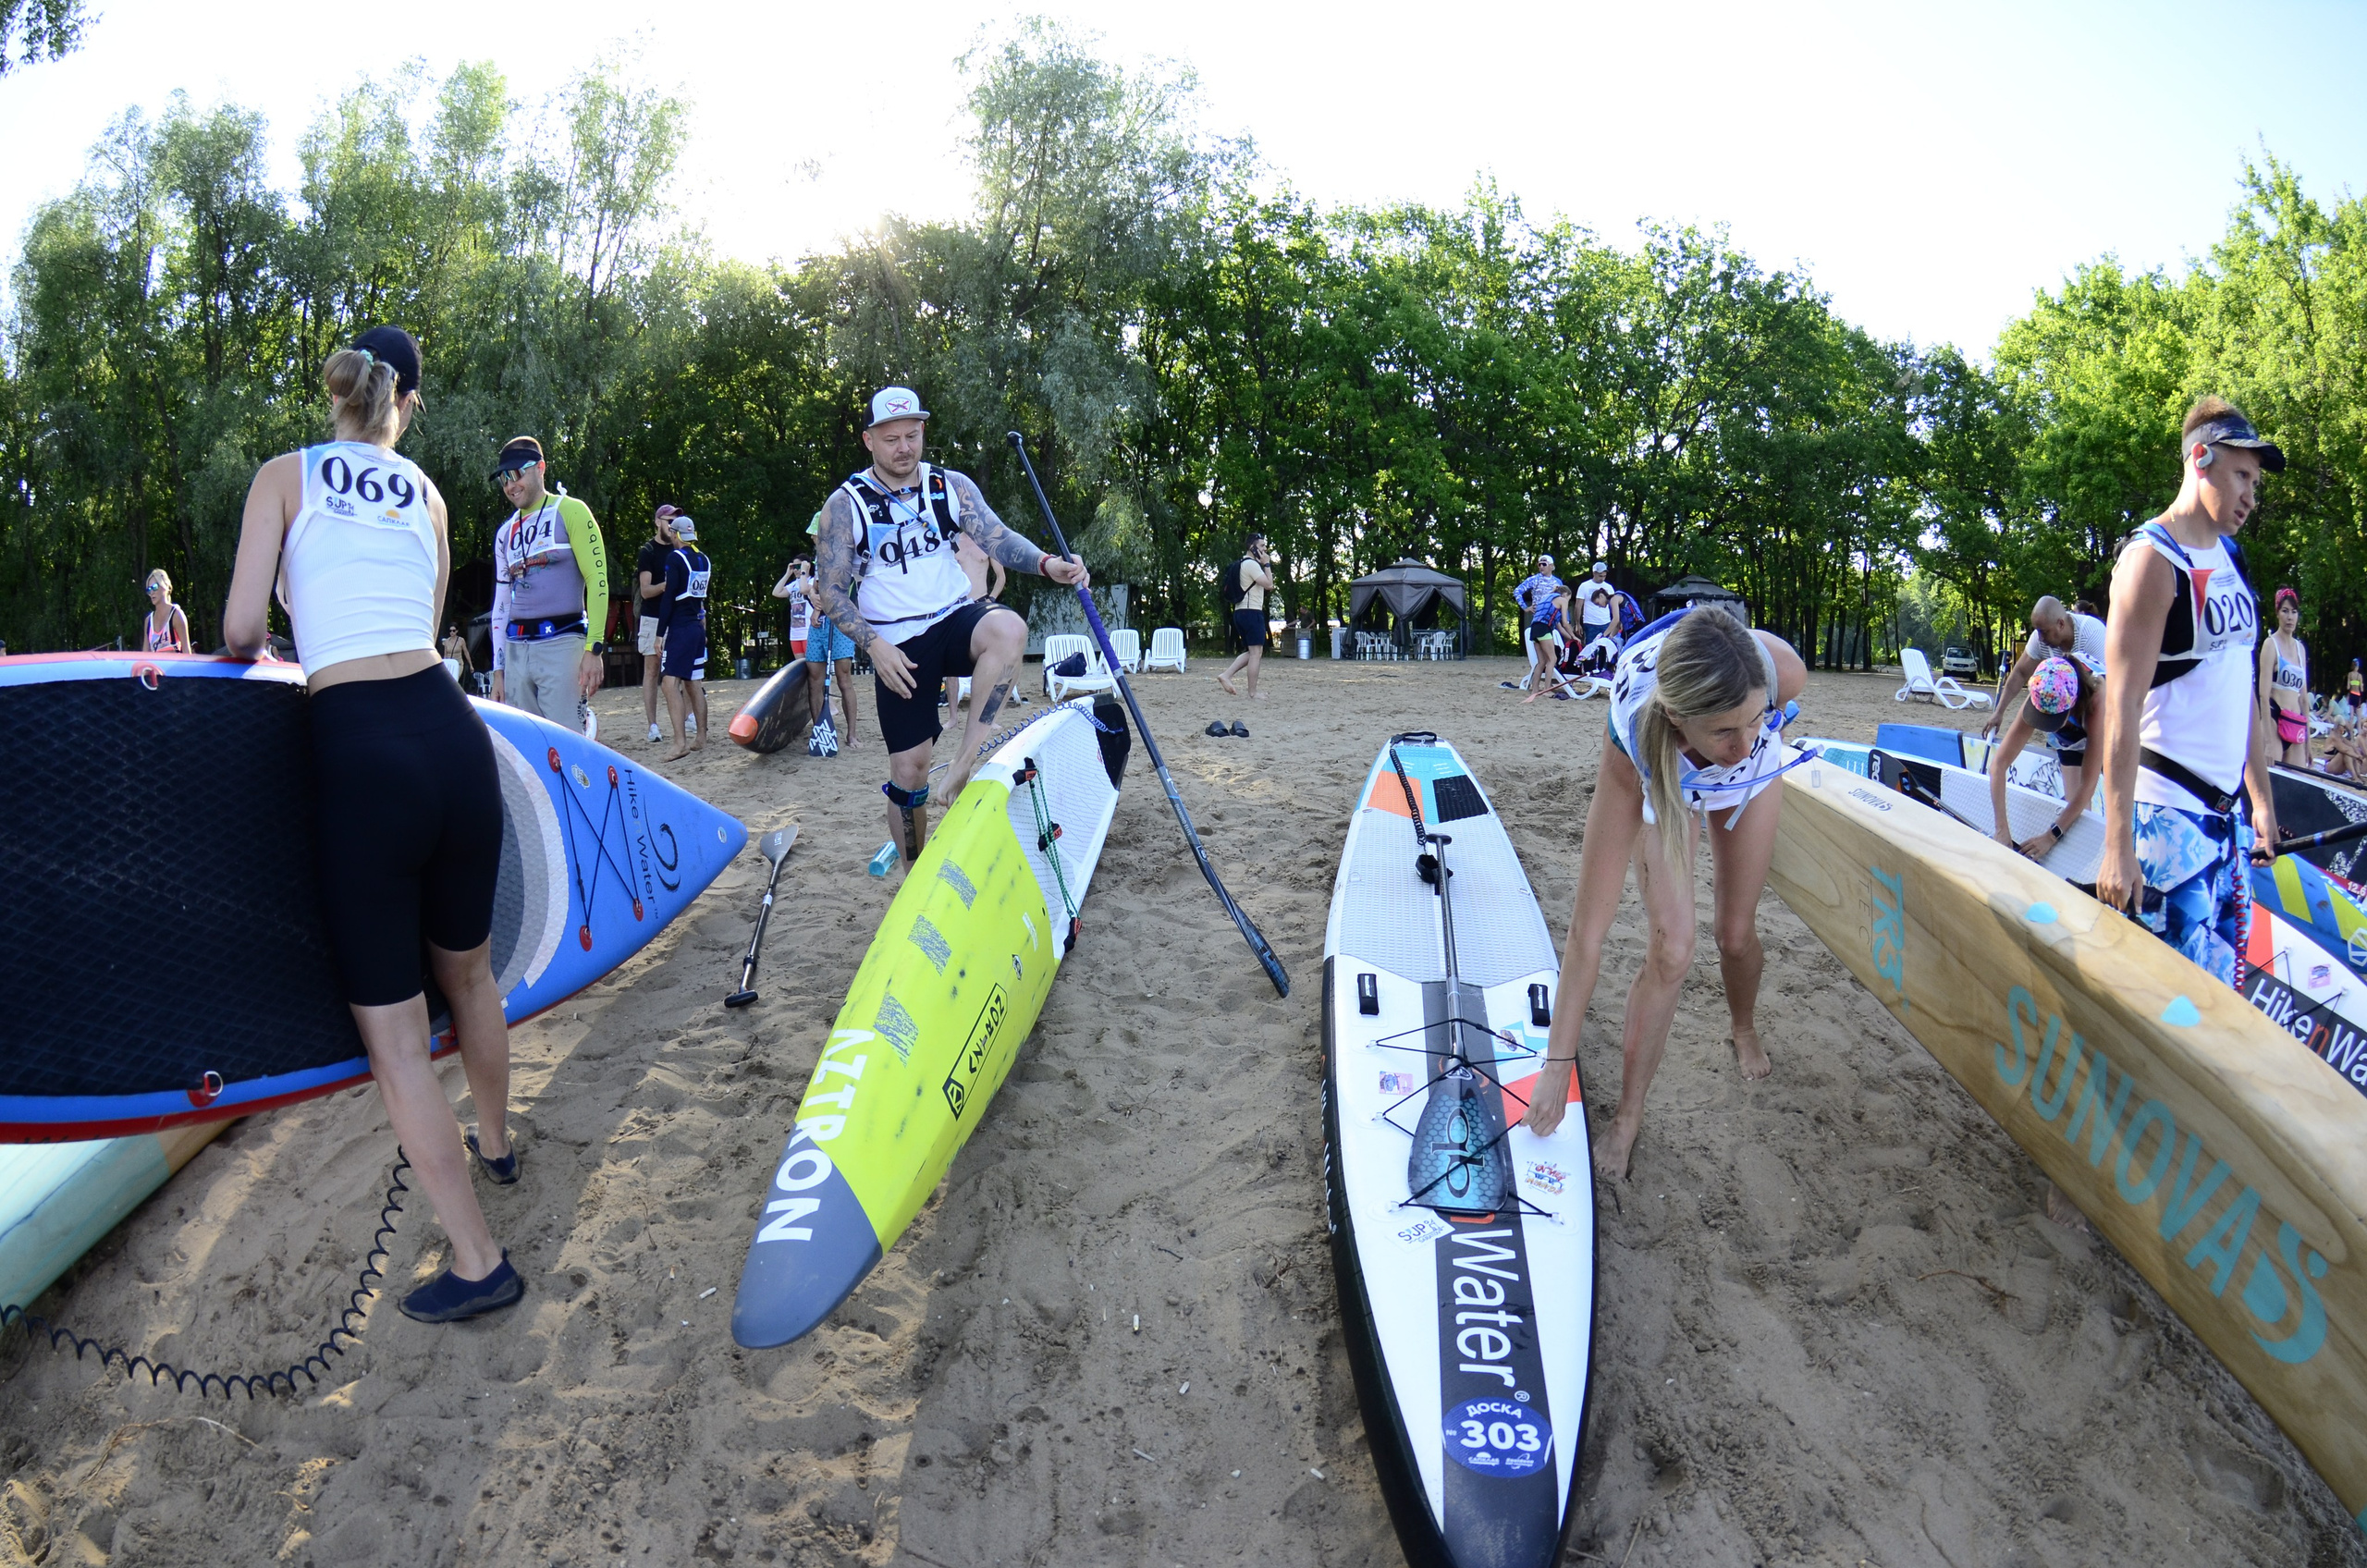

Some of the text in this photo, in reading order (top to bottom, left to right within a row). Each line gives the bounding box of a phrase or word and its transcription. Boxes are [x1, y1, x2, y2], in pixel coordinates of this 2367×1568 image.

[321, 456, 415, 508] 069
[509, 520, 552, 551] 004
[878, 529, 941, 565] 048
[2204, 592, 2253, 636] 020
[2282, 669, 2303, 689] 030
[2347, 880, 2367, 897] 12.6
[755, 1028, 876, 1243] AZTRON
[1466, 1403, 1523, 1418] ДОСКА
[1460, 1419, 1542, 1452] 303
